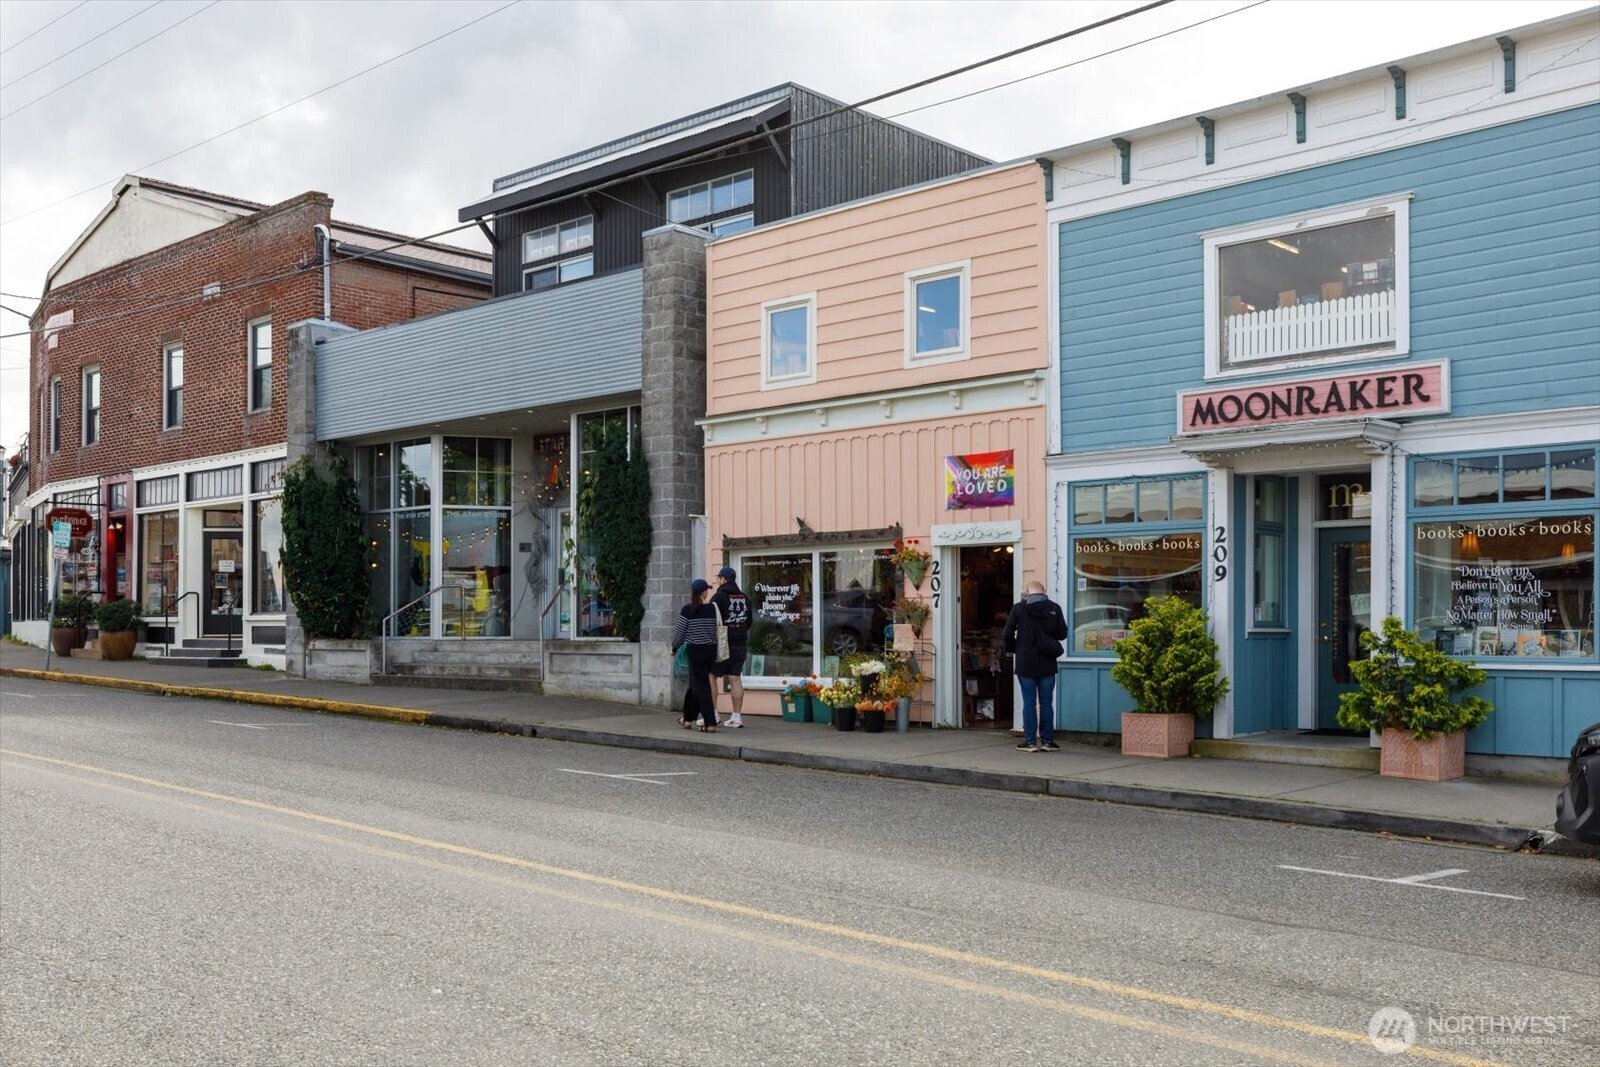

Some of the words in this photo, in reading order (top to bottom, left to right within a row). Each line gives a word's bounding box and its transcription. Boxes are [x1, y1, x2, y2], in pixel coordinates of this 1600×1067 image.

[1190, 373, 1431, 427] MOONRAKER
[956, 468, 981, 481] YOU
[983, 464, 1006, 479] ARE
[957, 478, 1008, 495] LOVED
[1417, 527, 1465, 540] books
[1477, 524, 1526, 537] books
[1539, 521, 1592, 535] books
[1076, 542, 1110, 553] books
[1118, 540, 1153, 552] books
[1162, 538, 1200, 550] books
[1213, 526, 1228, 582] 209
[1489, 565, 1513, 580] give
[755, 583, 790, 594] Wherever
[931, 561, 941, 608] 207
[1455, 580, 1488, 591] Believe
[1498, 578, 1524, 595] You
[1444, 610, 1462, 624] No
[1461, 607, 1496, 621] Matter
[1497, 609, 1519, 621] How
[1511, 622, 1535, 631] Seuss
